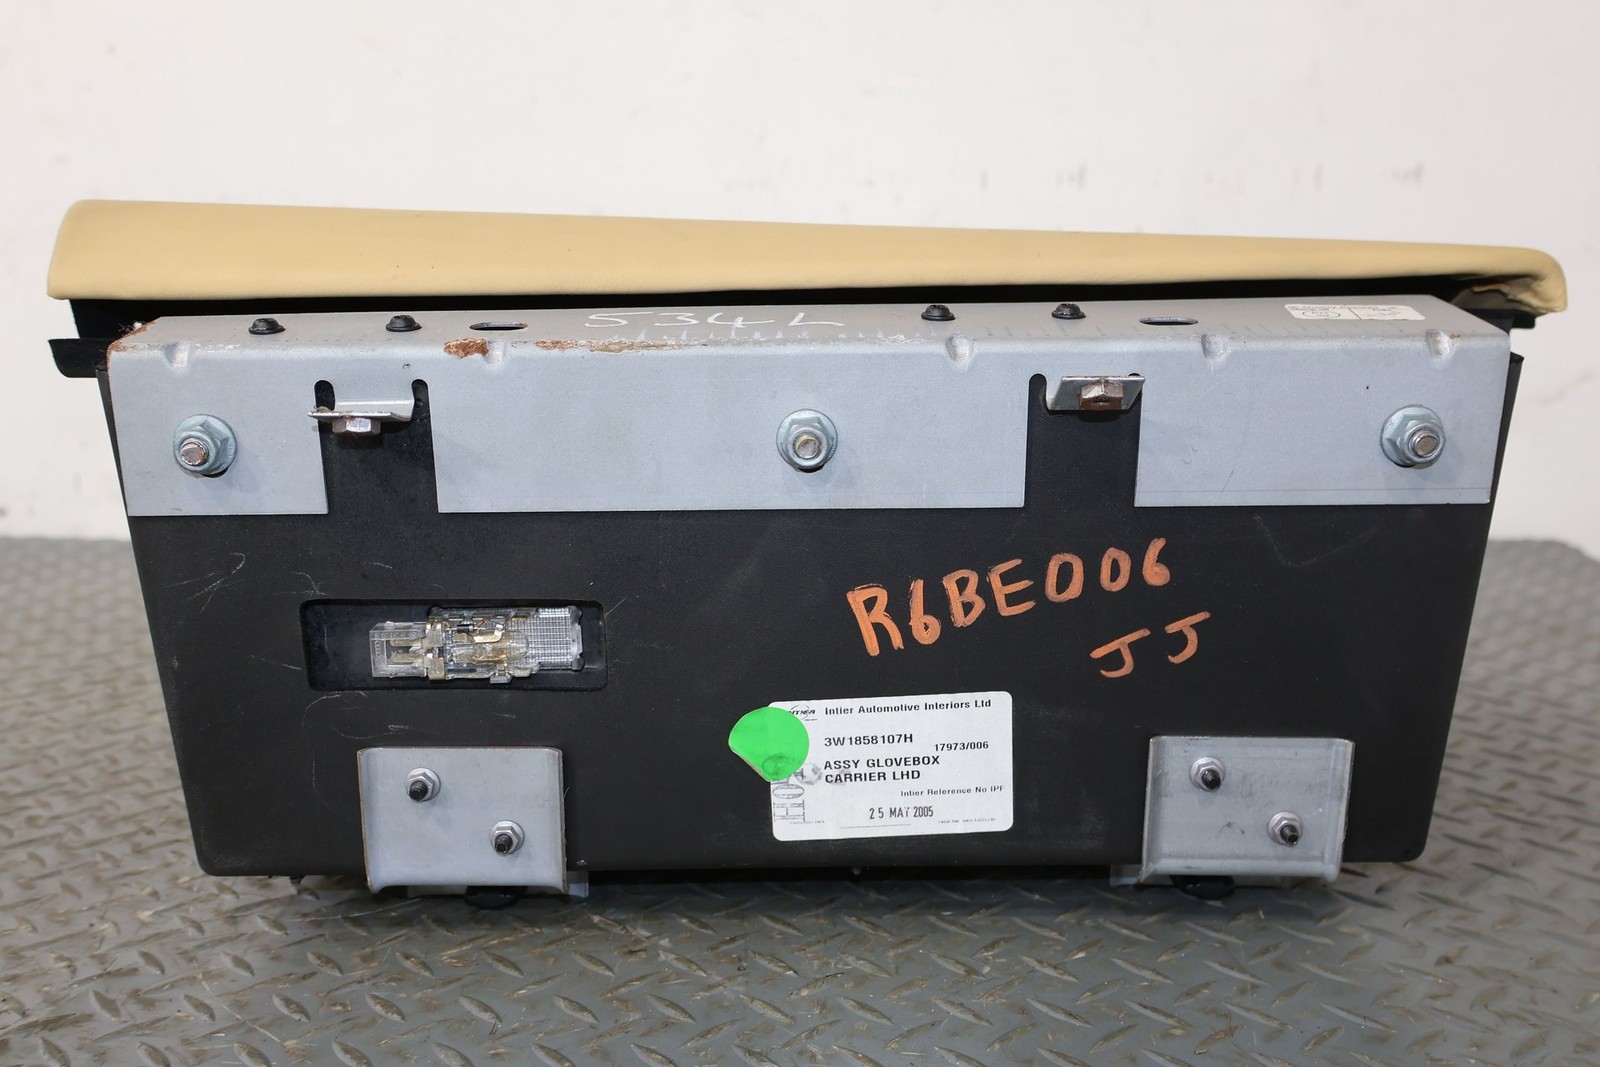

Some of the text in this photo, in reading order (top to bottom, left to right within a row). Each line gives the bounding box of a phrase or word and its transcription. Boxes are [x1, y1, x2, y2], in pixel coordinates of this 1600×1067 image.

[846, 537, 1171, 657] R6BE006
[824, 699, 992, 716] Intier Automotive Interiors Ltd
[824, 733, 914, 747] 3W1858107H
[934, 741, 990, 753] 17973/006
[824, 755, 941, 771] ASSY GLOVEBOX
[824, 769, 922, 784] CARRIER LHD
[900, 789, 925, 798] Intier
[927, 786, 973, 797] Reference
[975, 786, 987, 794] No
[889, 806, 911, 819] MAY
[913, 805, 934, 818] 2005
